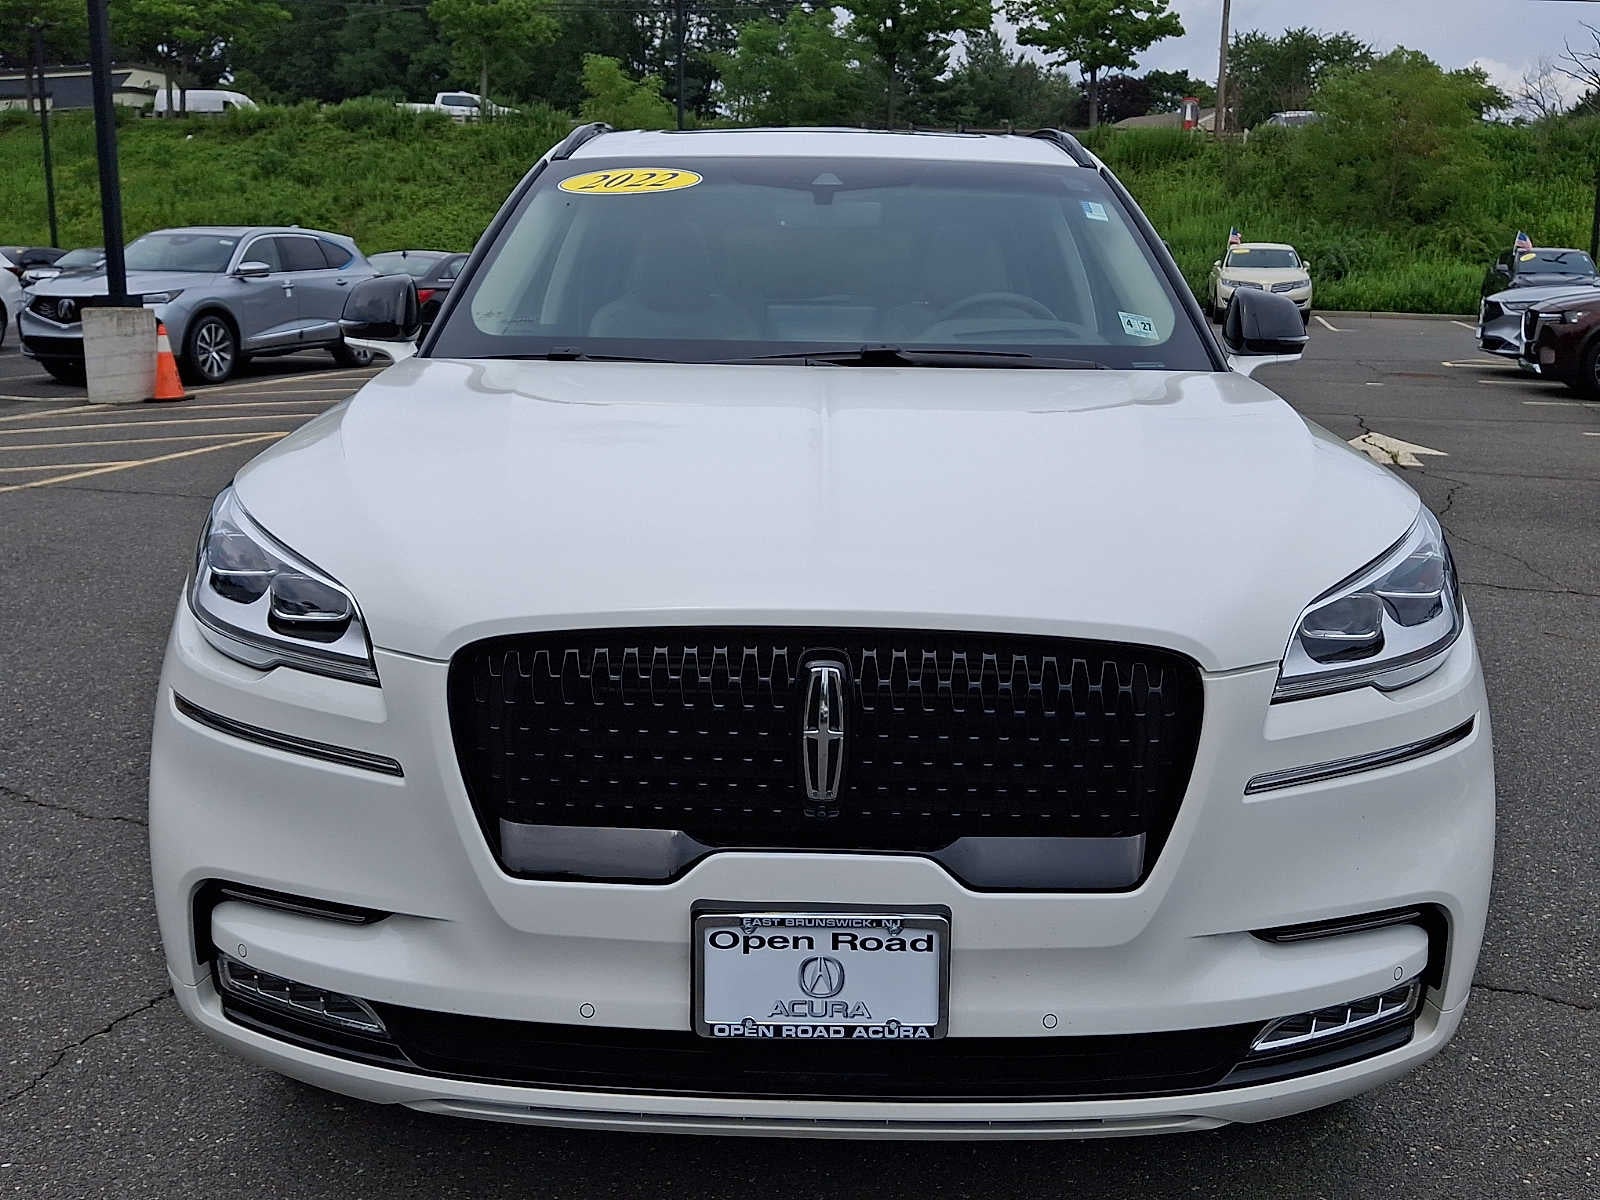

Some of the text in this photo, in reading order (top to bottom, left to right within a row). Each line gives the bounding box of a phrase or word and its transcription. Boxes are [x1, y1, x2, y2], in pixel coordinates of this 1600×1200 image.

[578, 173, 679, 190] 2022
[1126, 319, 1153, 332] 4 27
[743, 918, 781, 927] EAST
[881, 919, 901, 928] NJ
[708, 930, 934, 954] Open Road
[768, 1000, 872, 1019] ACURA
[713, 1024, 931, 1039] OPEN ROAD ACURA
